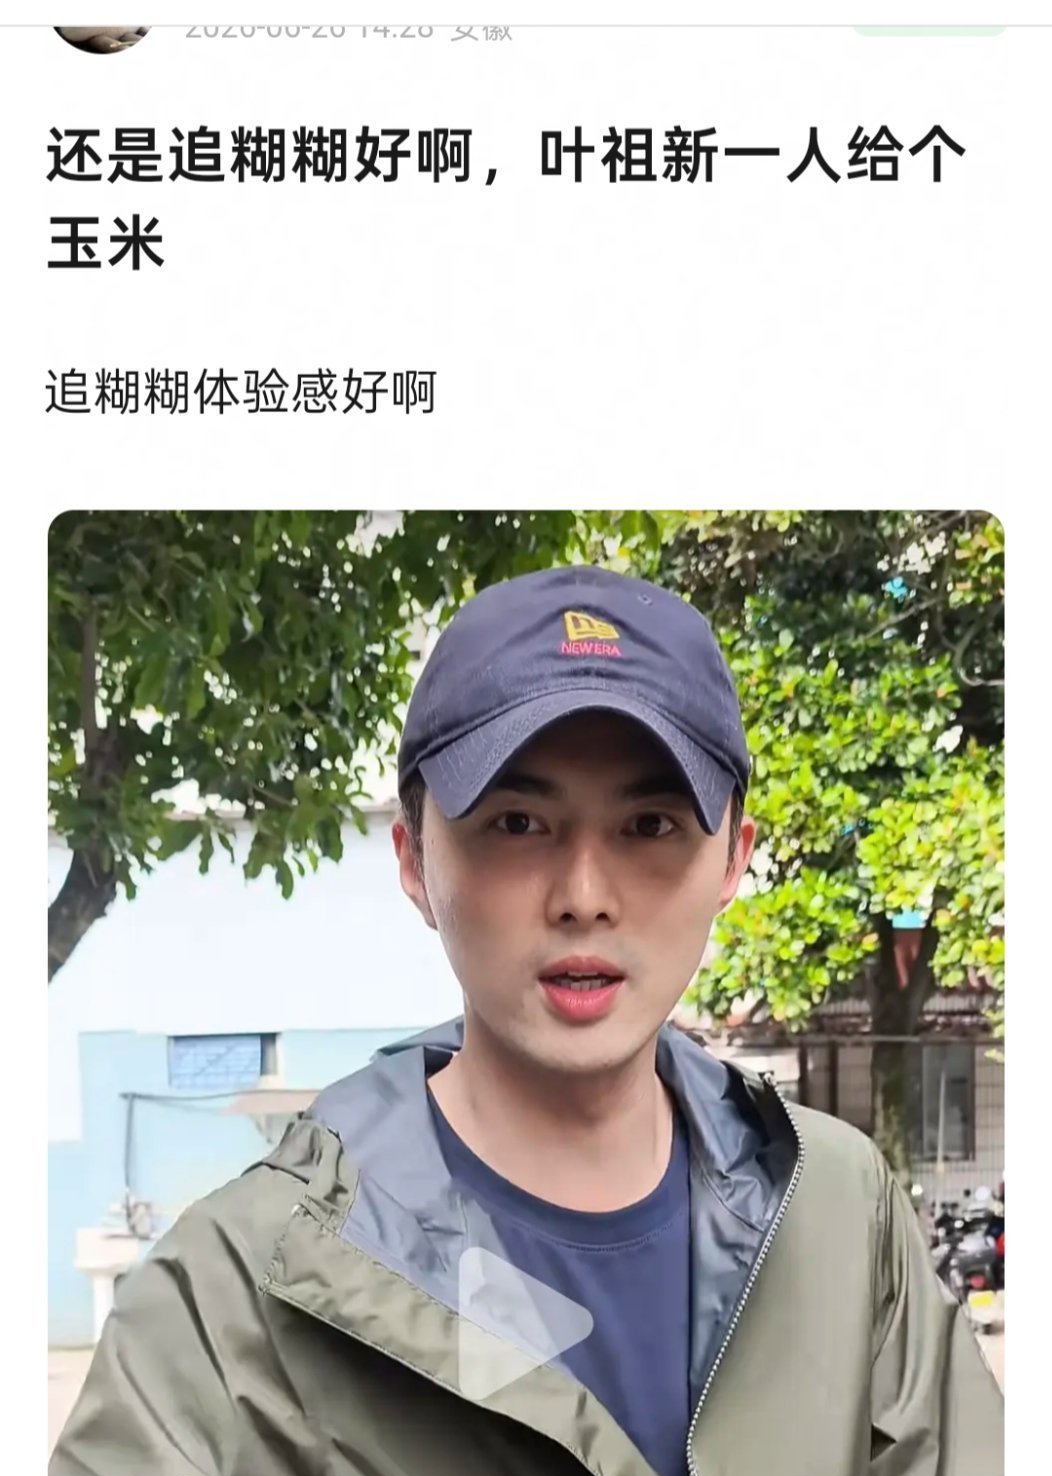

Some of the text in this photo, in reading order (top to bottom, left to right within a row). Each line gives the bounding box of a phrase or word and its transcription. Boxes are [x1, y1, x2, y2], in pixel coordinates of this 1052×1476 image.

[46, 124, 966, 186] 还是追糊糊好啊，叶祖新一人给个
[47, 213, 165, 271] 玉米
[45, 367, 437, 415] 追糊糊体验感好啊
